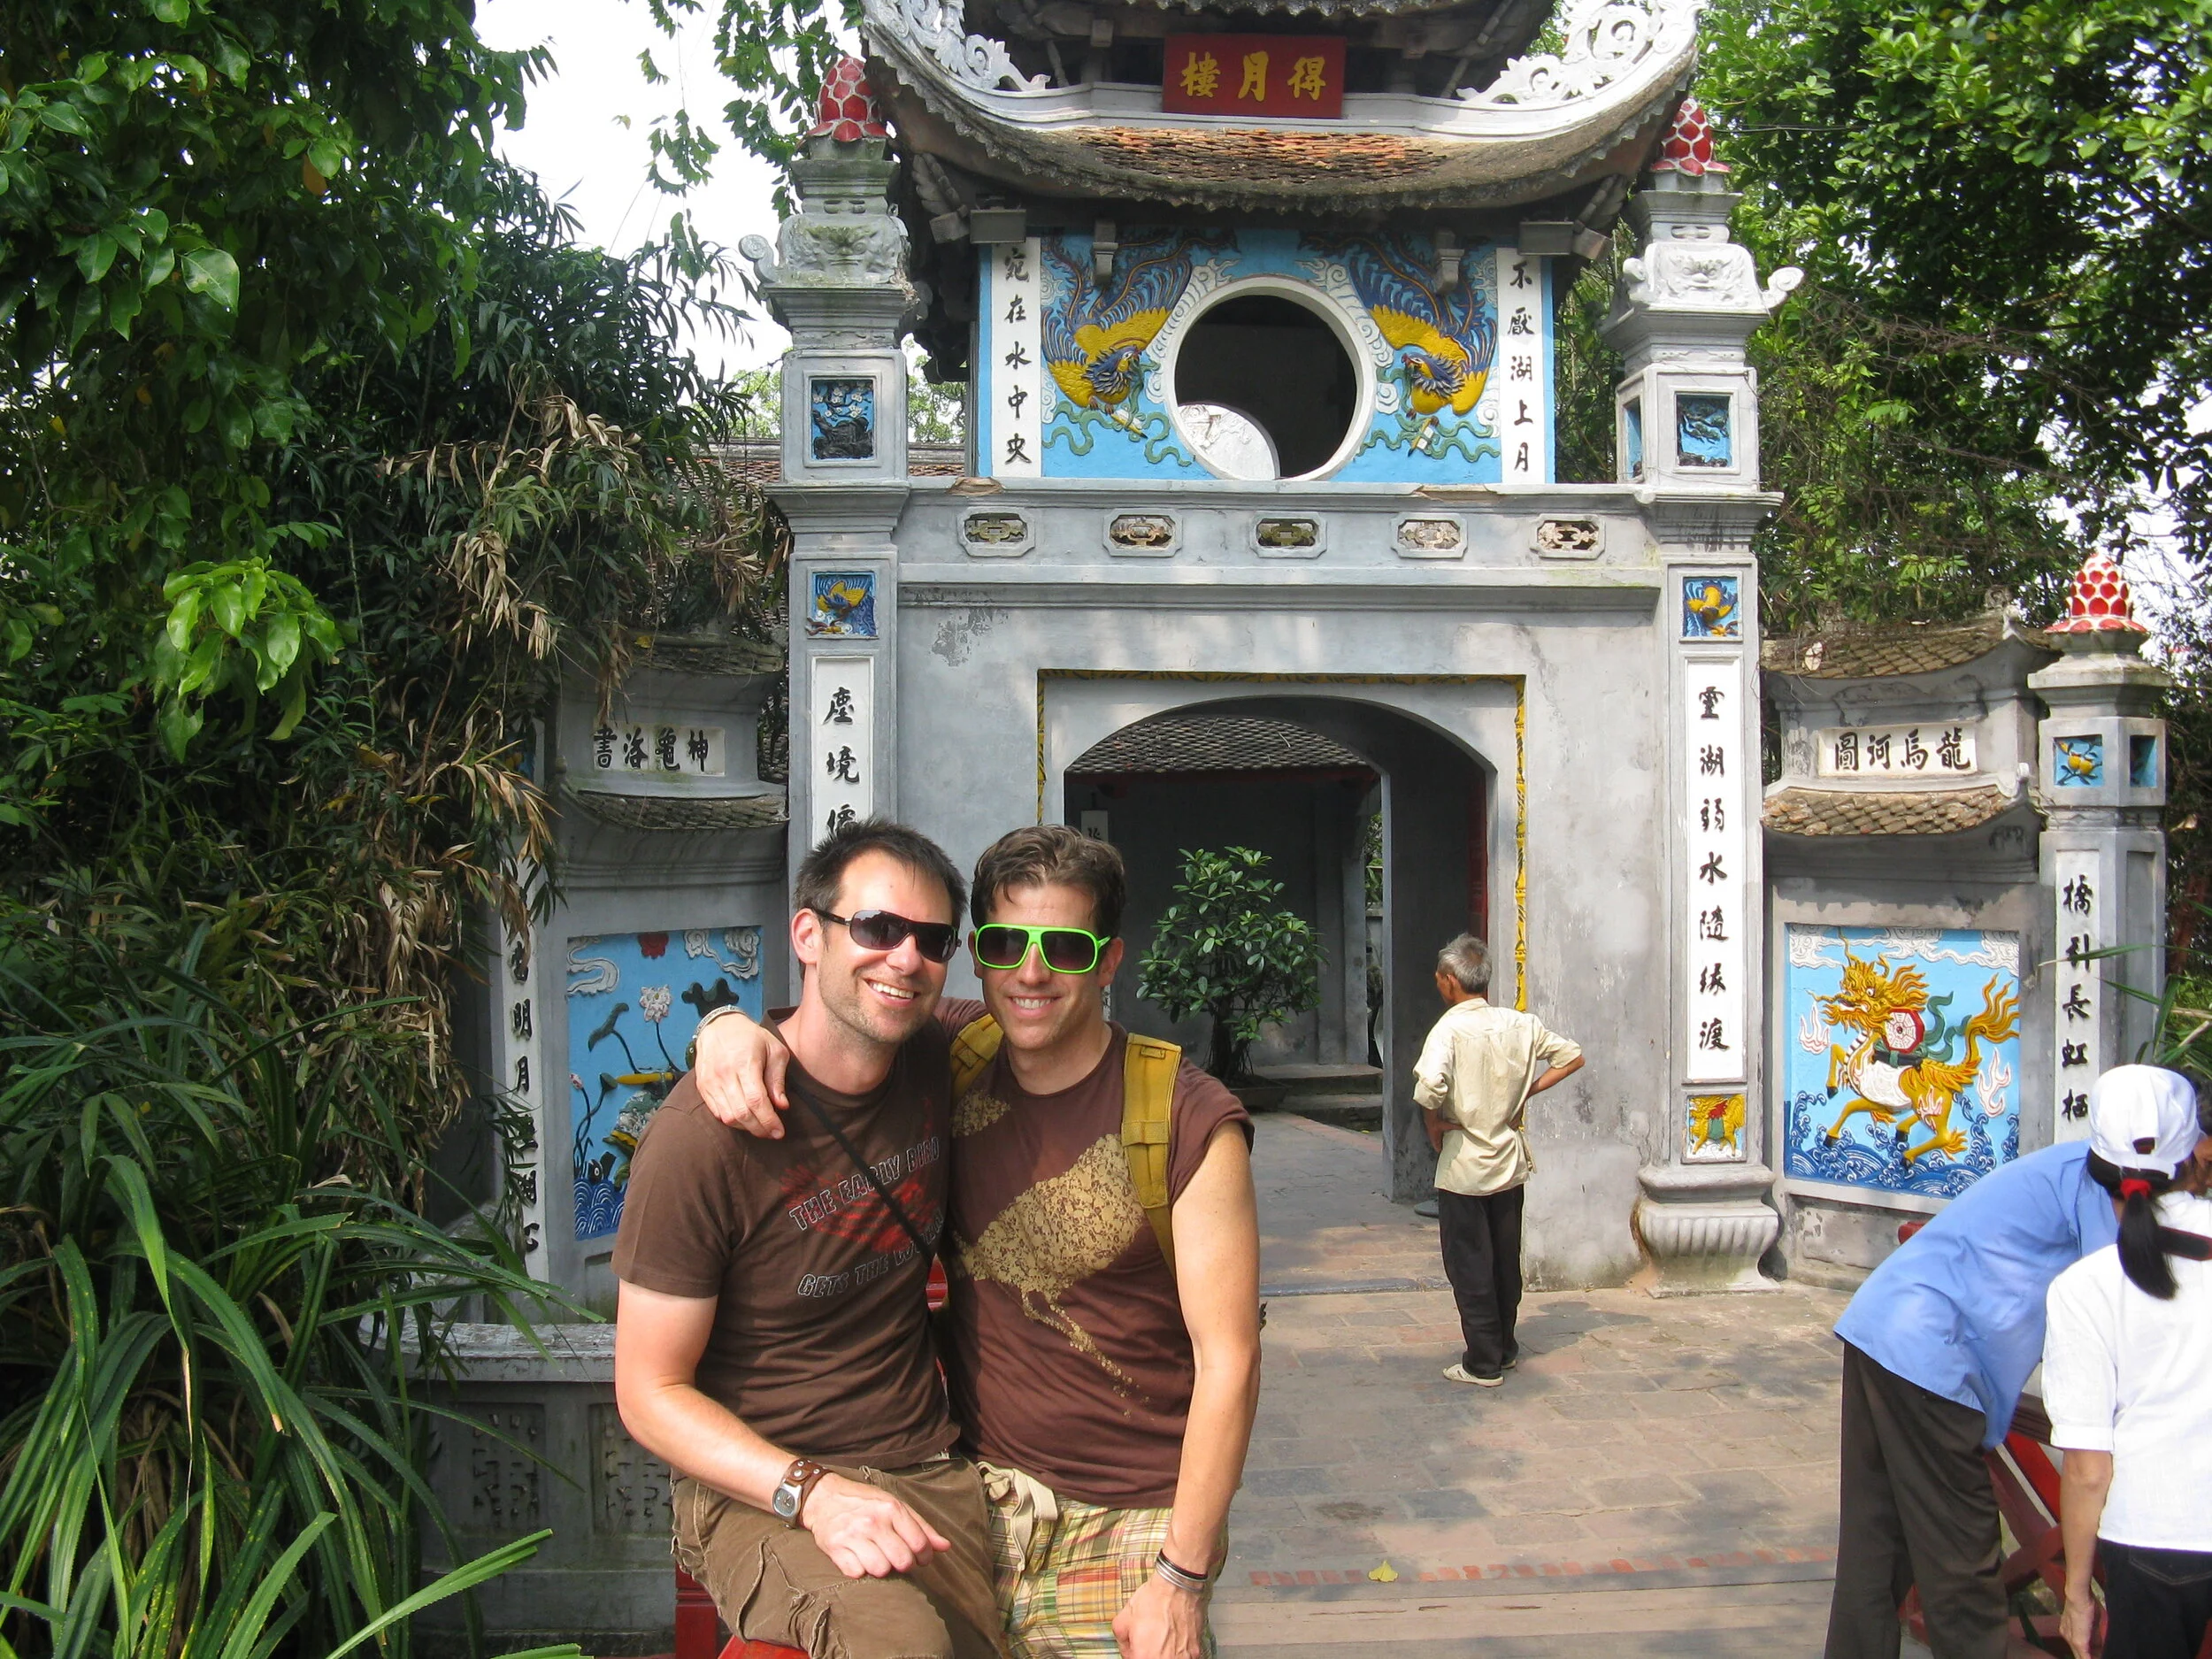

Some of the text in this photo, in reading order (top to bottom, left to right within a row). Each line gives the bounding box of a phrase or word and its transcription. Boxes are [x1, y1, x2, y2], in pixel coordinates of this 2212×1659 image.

[788, 1189, 838, 1231] THE
[906, 1136, 940, 1172] BIRD
[797, 1271, 849, 1298] GETS
[855, 1253, 889, 1286] THE
